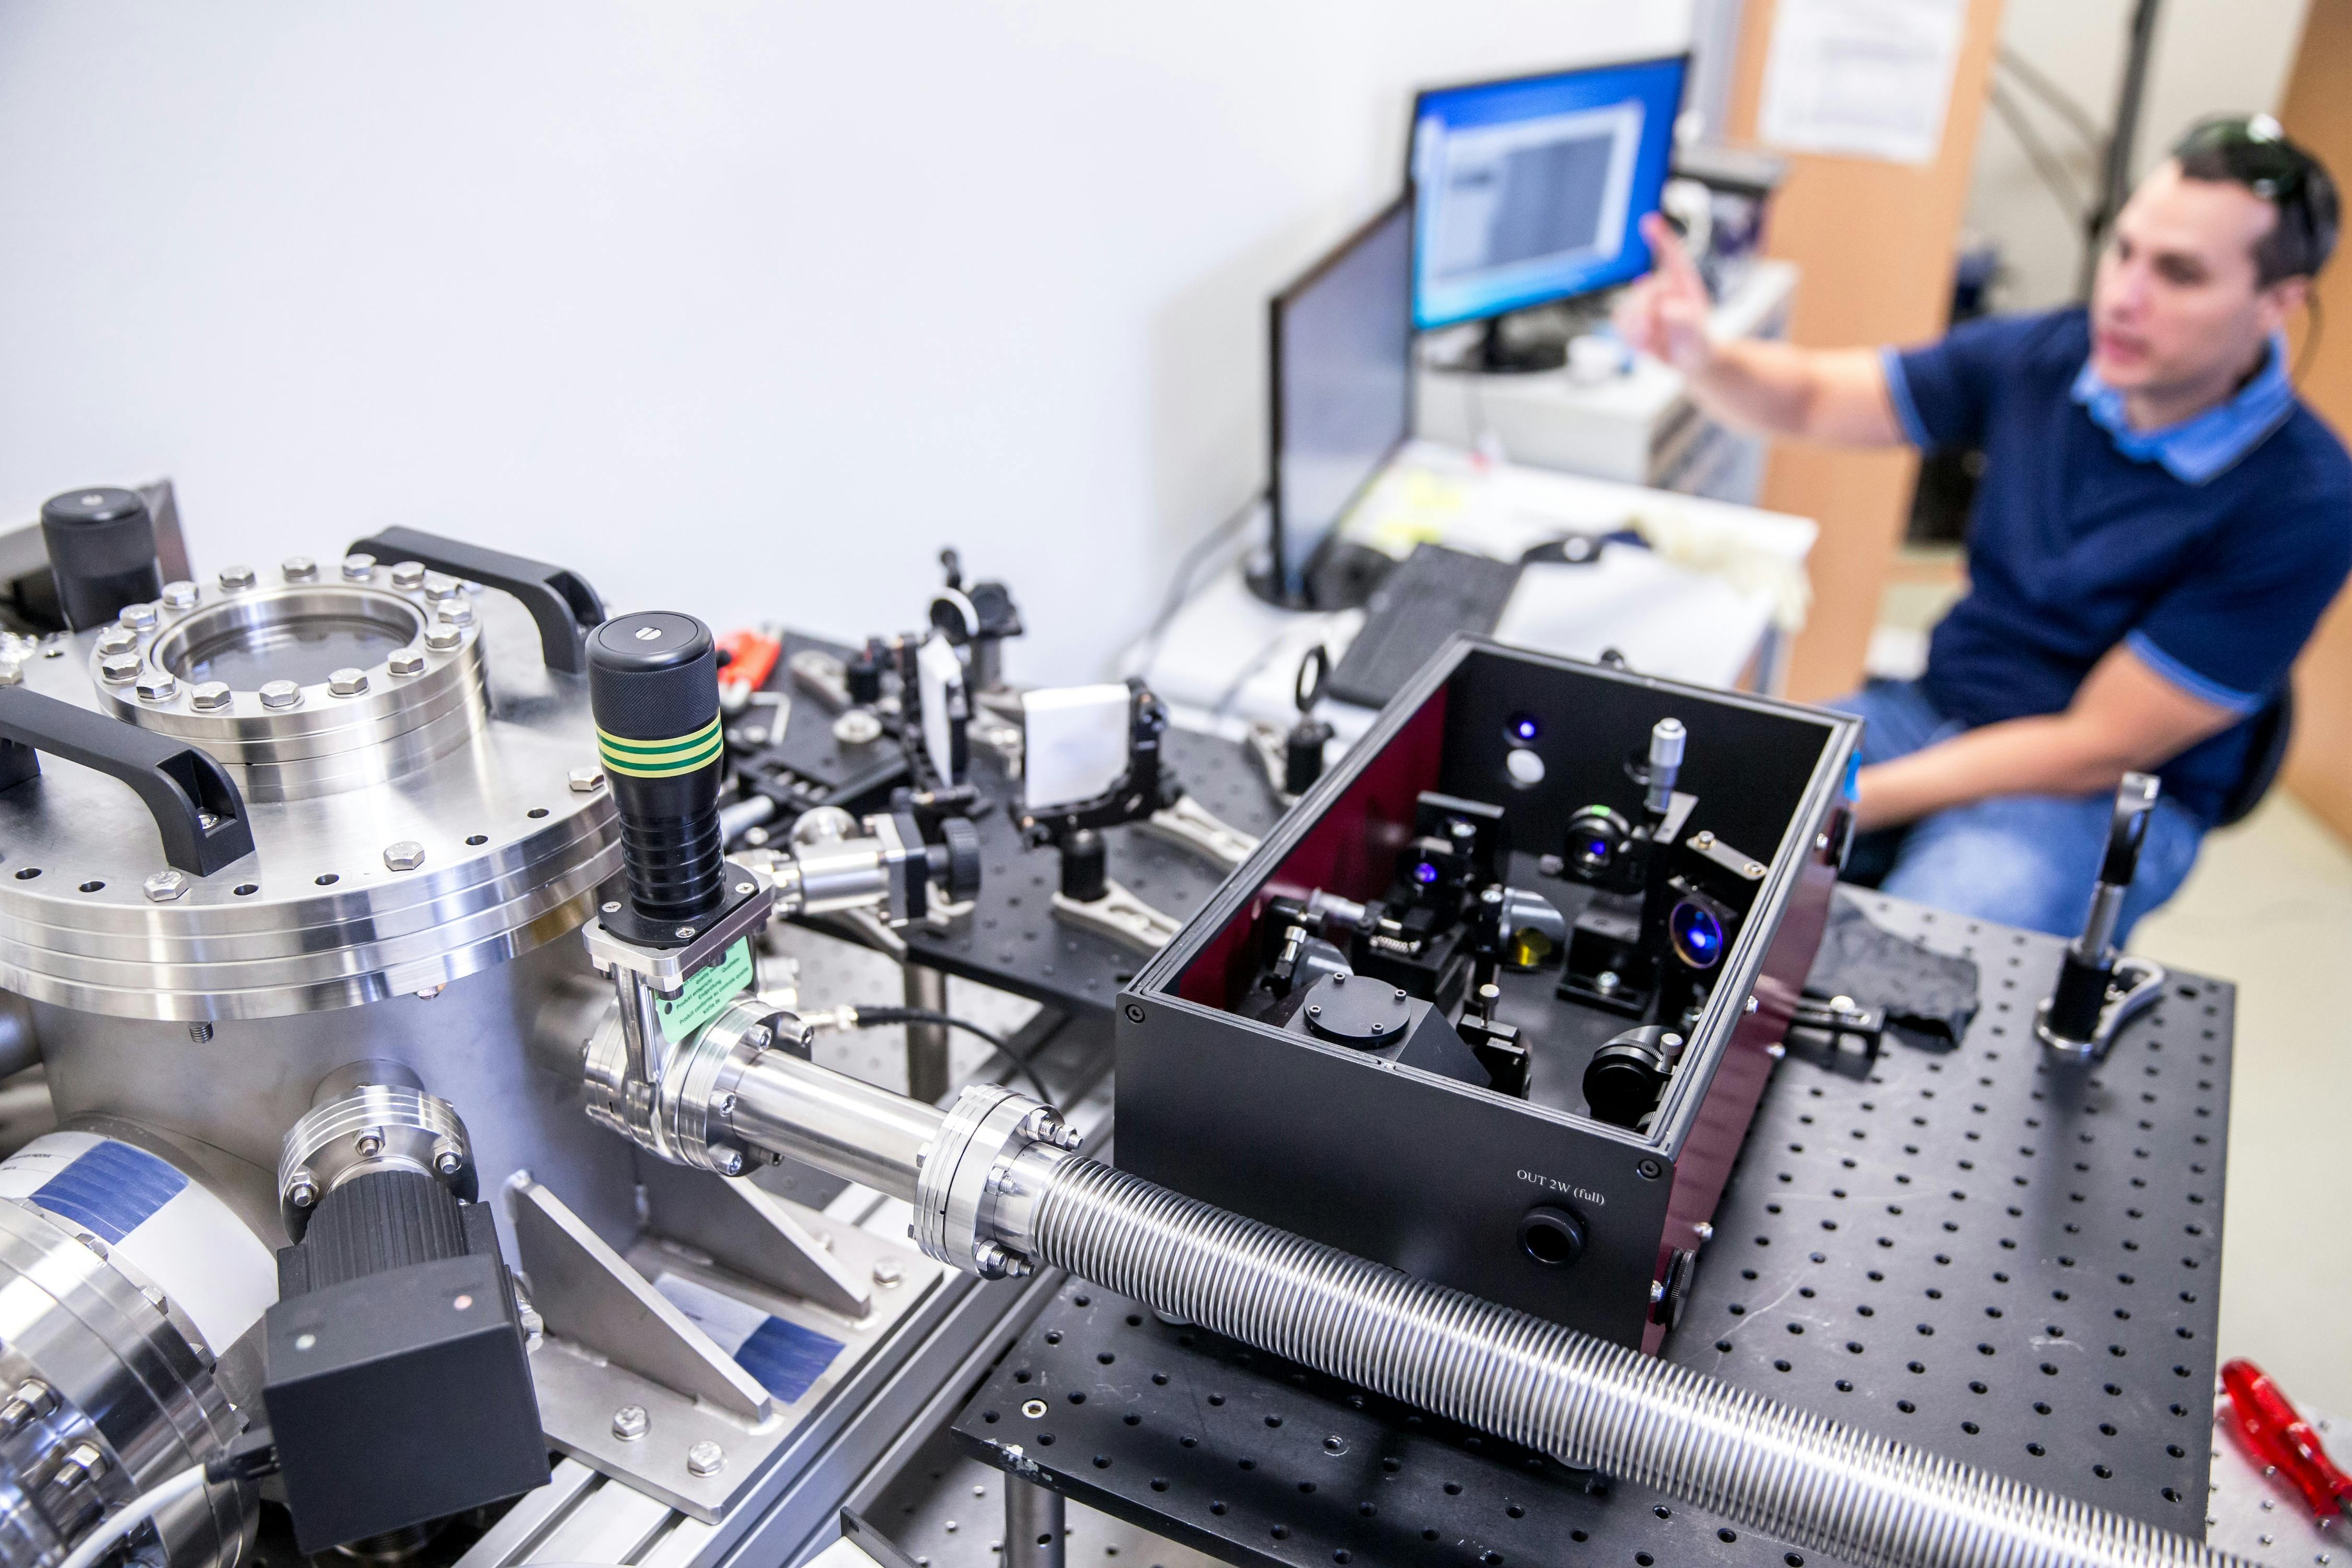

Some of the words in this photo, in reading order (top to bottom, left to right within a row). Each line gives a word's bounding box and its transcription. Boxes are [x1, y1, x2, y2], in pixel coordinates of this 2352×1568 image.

[676, 994, 693, 1010] Produkt
[679, 1010, 694, 1024] Produit
[695, 995, 712, 1012] conforme
[1517, 1169, 1547, 1186] OUT
[1550, 1179, 1571, 1193] 2W
[1573, 1187, 1605, 1206] (full)
